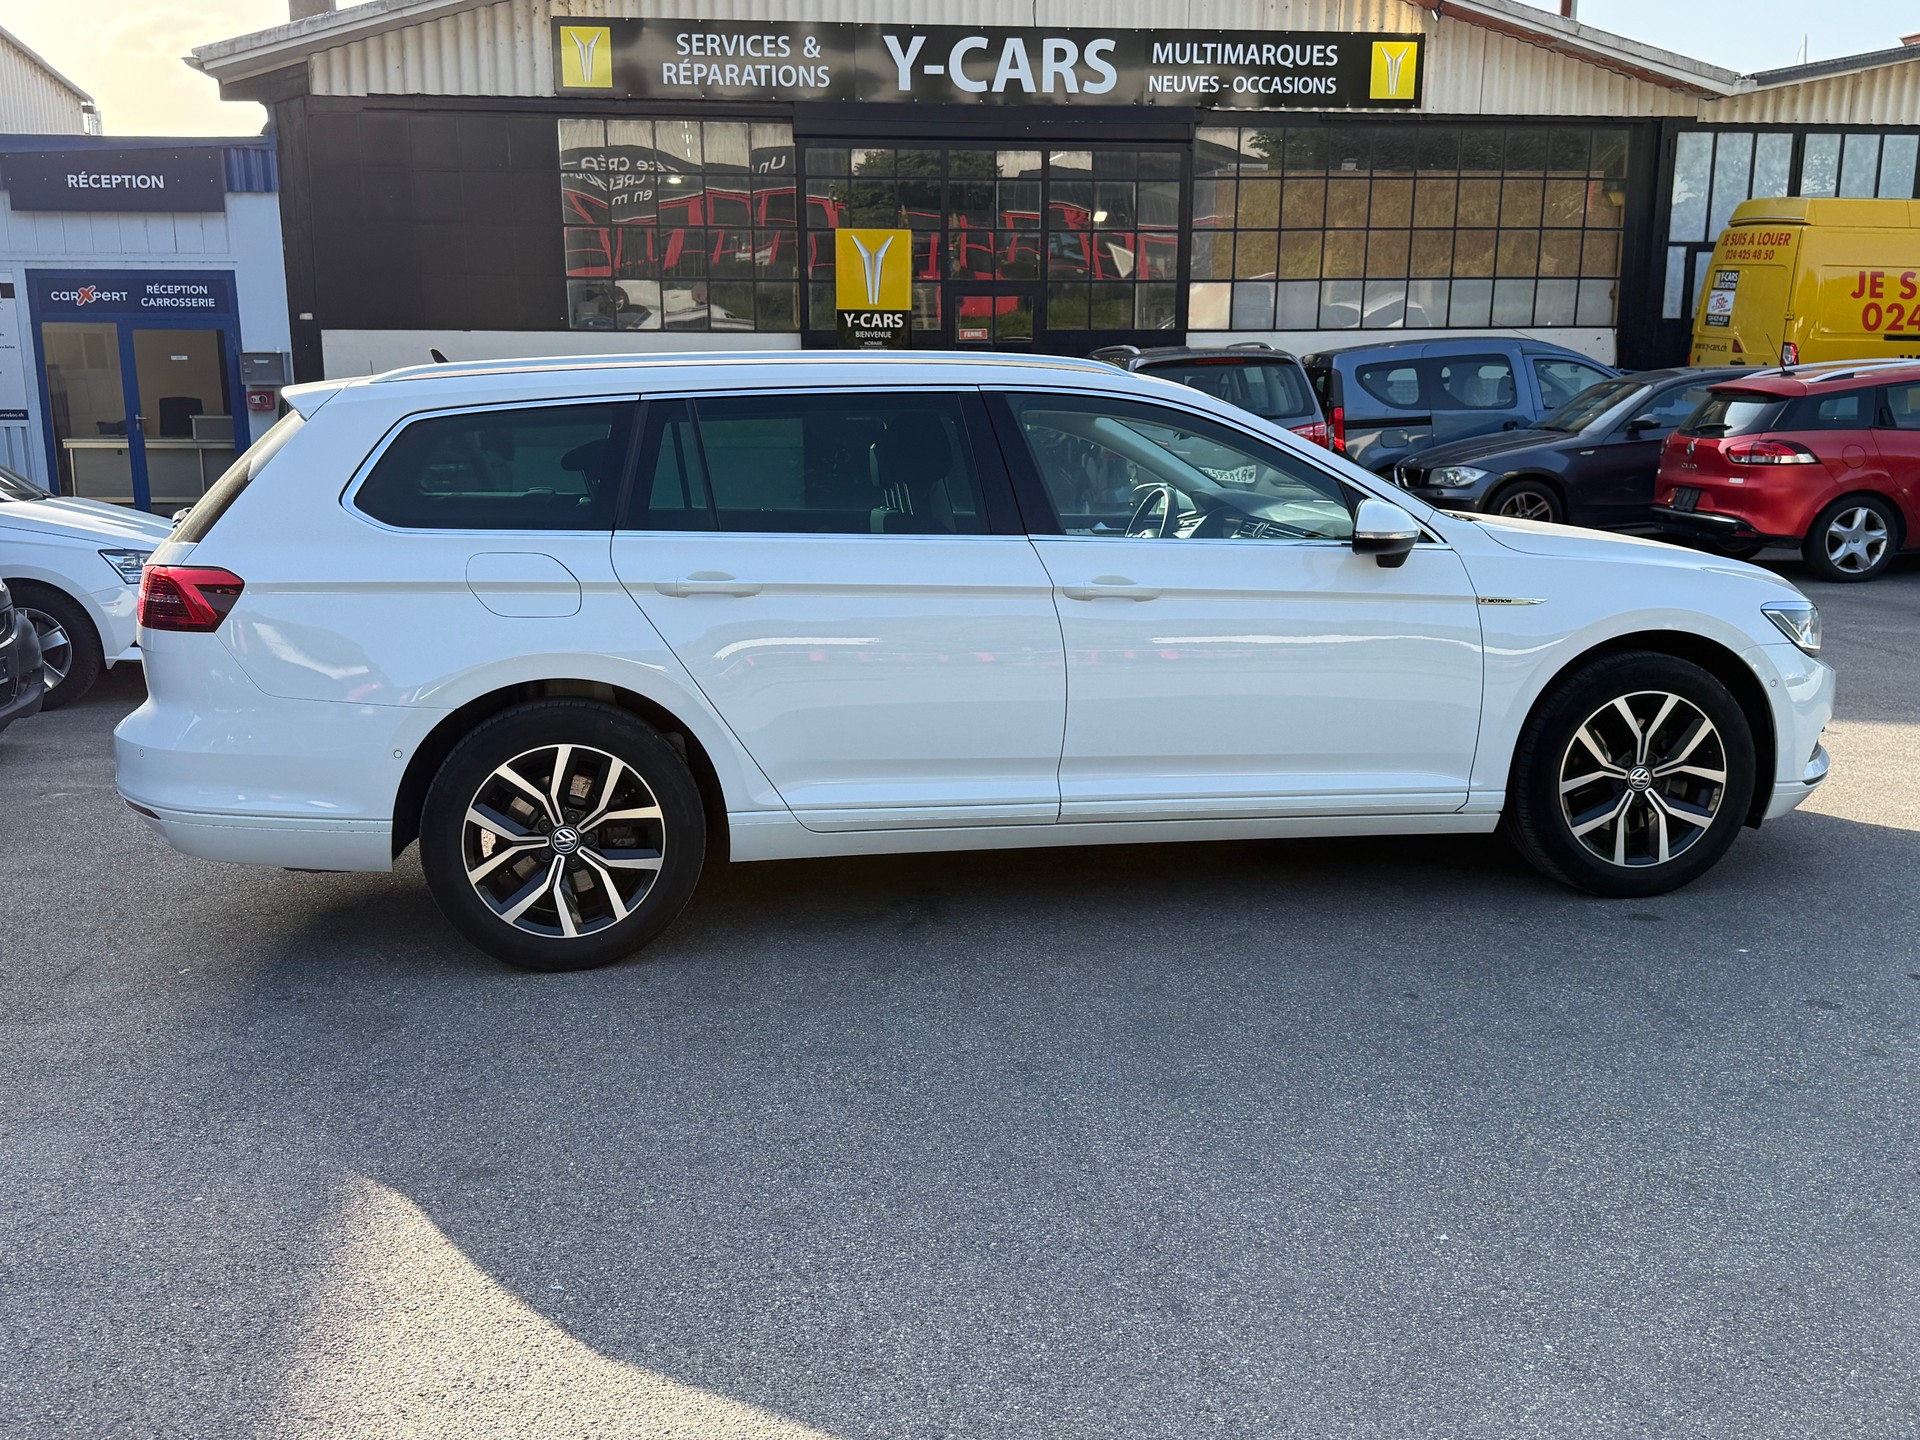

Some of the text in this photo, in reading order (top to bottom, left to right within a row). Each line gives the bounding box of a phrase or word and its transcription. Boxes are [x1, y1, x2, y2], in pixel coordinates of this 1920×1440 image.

[676, 33, 821, 58] SERVICES &
[1152, 42, 1339, 69] MULTIMARQUES
[662, 59, 831, 88] RÉPARATIONS
[882, 35, 1118, 95] Y-CARS
[1148, 75, 1220, 94] NEUVES
[1232, 76, 1337, 95] OCCASIONS
[66, 171, 165, 189] RÉCEPTION
[1730, 233, 1748, 247] SUIS
[1757, 232, 1792, 247] LOUER
[1763, 249, 1775, 260] 50
[146, 283, 208, 295] RÉCEPTION
[1851, 271, 1885, 299] JE
[140, 297, 216, 307] CARROSSERIE
[843, 313, 904, 328] Y-CARS
[1861, 302, 1920, 332] 024
